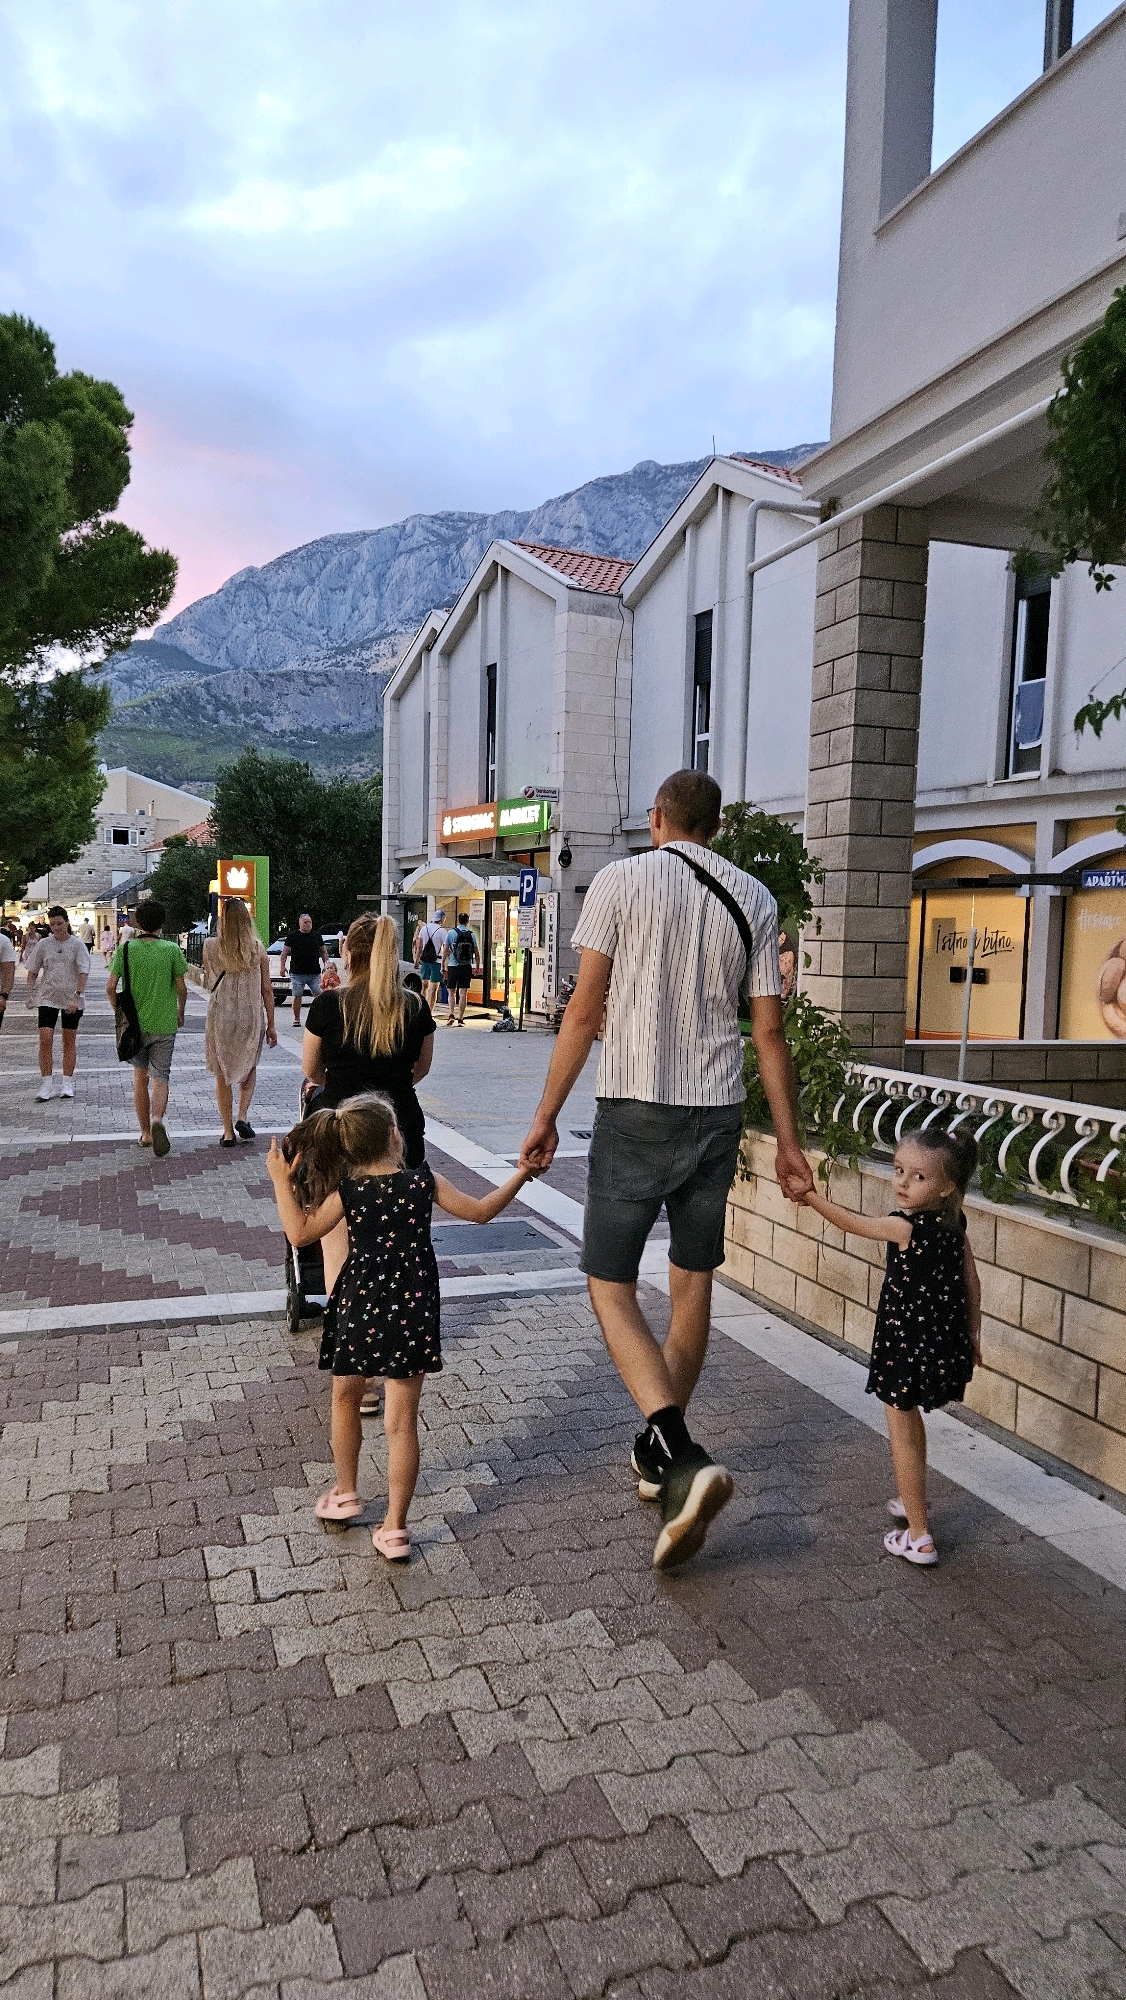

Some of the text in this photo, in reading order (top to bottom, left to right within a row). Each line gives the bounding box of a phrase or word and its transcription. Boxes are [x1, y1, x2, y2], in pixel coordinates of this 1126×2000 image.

[499, 804, 541, 826] MARKET
[522, 874, 534, 903] P
[941, 930, 968, 955] sitno
